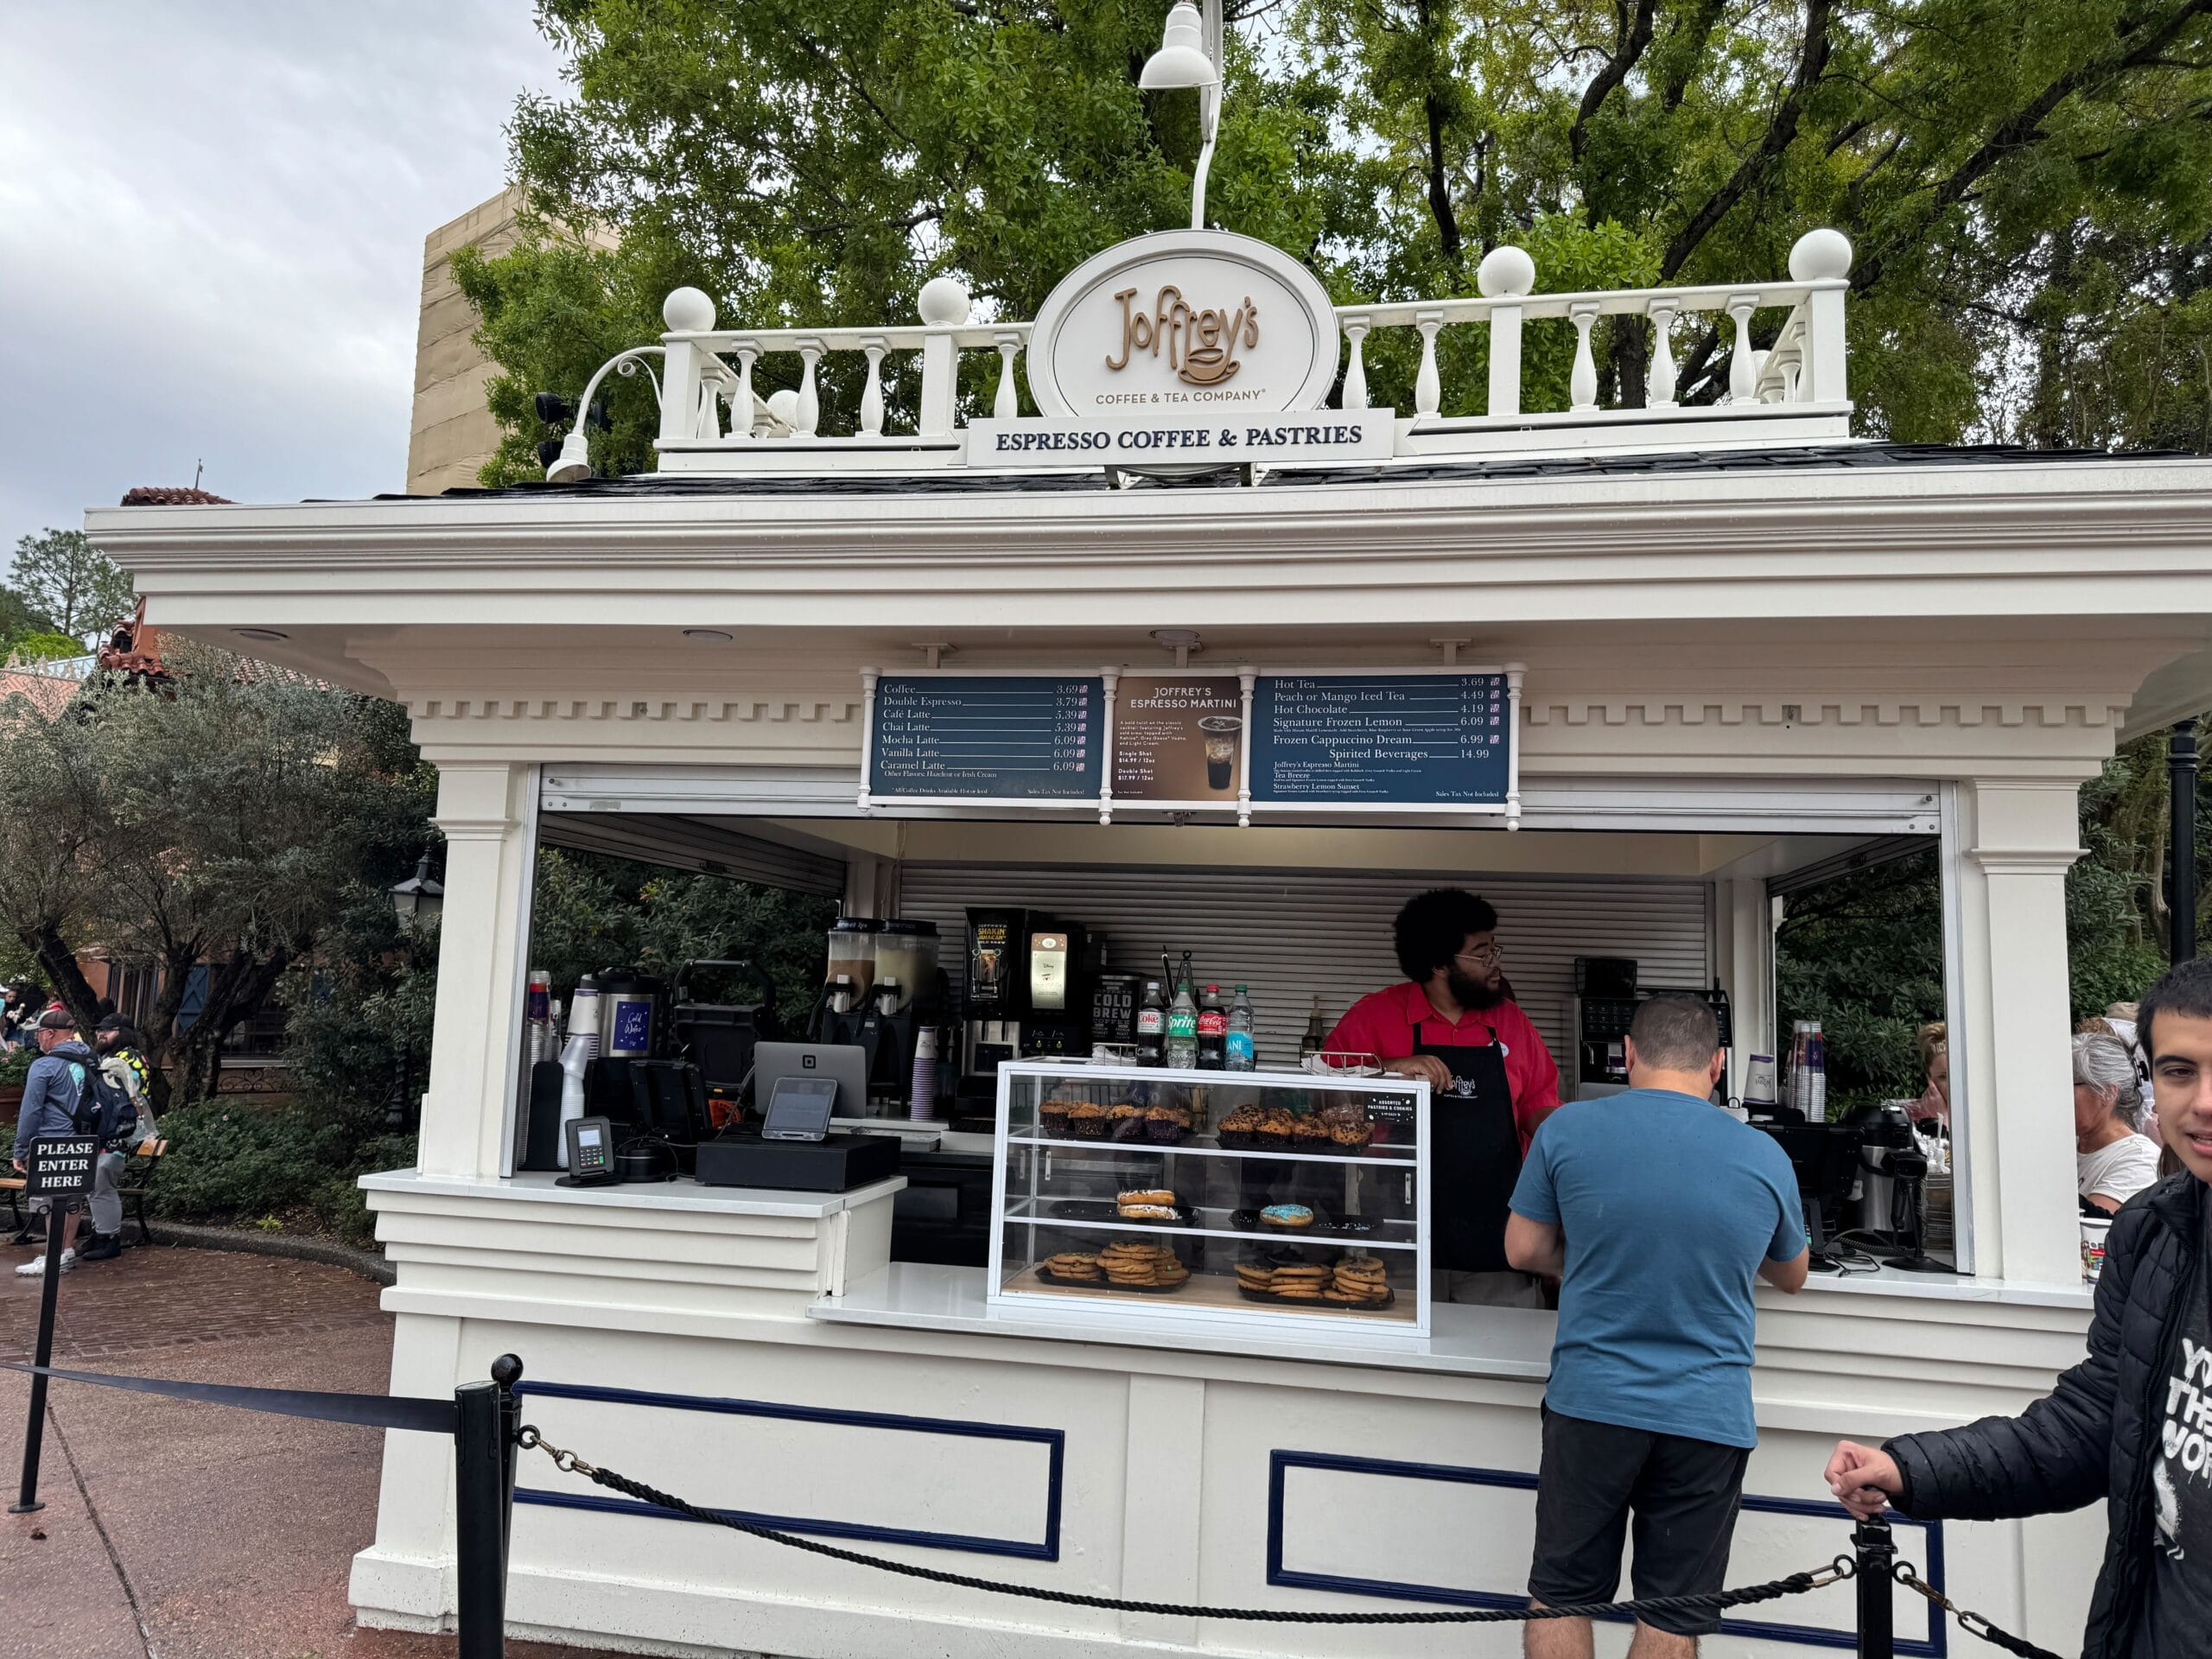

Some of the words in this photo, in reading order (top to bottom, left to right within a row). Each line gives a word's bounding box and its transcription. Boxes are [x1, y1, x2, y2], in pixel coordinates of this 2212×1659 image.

[1106, 285, 1259, 371] Joffrey's
[1096, 393, 1147, 404] COFFEE
[1151, 394, 1160, 404] &
[1163, 392, 1189, 404] TEA
[995, 432, 1110, 451] ESPRESSO
[1117, 430, 1210, 449] COFFEE
[1219, 429, 1237, 448] &
[1245, 425, 1363, 446] PASTRIES
[884, 684, 916, 694] Coffee
[1056, 685, 1078, 694] 3.69
[1275, 680, 1294, 689] Hot
[1296, 680, 1315, 689] Tea
[1461, 678, 1484, 687] 3.69
[1154, 688, 1211, 698] JOFFREY'S
[1274, 692, 1303, 702] Peach
[1321, 692, 1357, 702] Mango
[1361, 691, 1383, 701] Iced
[1386, 691, 1405, 701] Tea
[1461, 691, 1484, 700] 4.49
[884, 697, 918, 706] Double
[921, 697, 962, 708] Espresso
[1056, 697, 1077, 707] 3.79
[1130, 699, 1187, 709] ESPRESSO
[1191, 699, 1236, 709] MARTINI
[883, 709, 905, 719] Café
[907, 709, 931, 719] Latte
[1055, 710, 1077, 720] 5.39
[1274, 705, 1294, 714] Hot
[1296, 704, 1348, 714] Chocolate
[1461, 704, 1484, 713] 4.19
[882, 722, 904, 731] Chai
[907, 722, 931, 731] Latte
[1054, 723, 1077, 733] 5.39
[1273, 718, 1323, 729] Signature
[1326, 717, 1362, 727] Frozen
[1365, 717, 1402, 727] Lemon
[1460, 717, 1484, 726] 6.09
[882, 734, 913, 744] Mocha
[917, 734, 940, 744] Latte
[1054, 736, 1077, 745] 6.09
[1274, 735, 1308, 744] Frozen
[1311, 734, 1373, 747] Cappuccino
[1376, 734, 1413, 744] Dream
[1460, 735, 1484, 744] 6.99
[881, 747, 913, 757] Vanilla
[917, 747, 940, 757] Latte
[1054, 748, 1076, 758] 6.09
[1329, 749, 1370, 760] Spirited
[1375, 748, 1428, 760] Beverages
[1461, 749, 1490, 759] 14.99
[880, 760, 918, 769] Caramel
[922, 760, 945, 770] Latte
[1053, 761, 1075, 771] 6.09
[1093, 994, 1132, 1007] COLD
[1093, 1007, 1132, 1019] BREW
[1169, 1015, 1196, 1030] Sprite
[1227, 1040, 1242, 1051] ANI
[37, 1143, 93, 1155] PLEASE
[38, 1160, 88, 1172] ENTER
[41, 1175, 82, 1188] HERE
